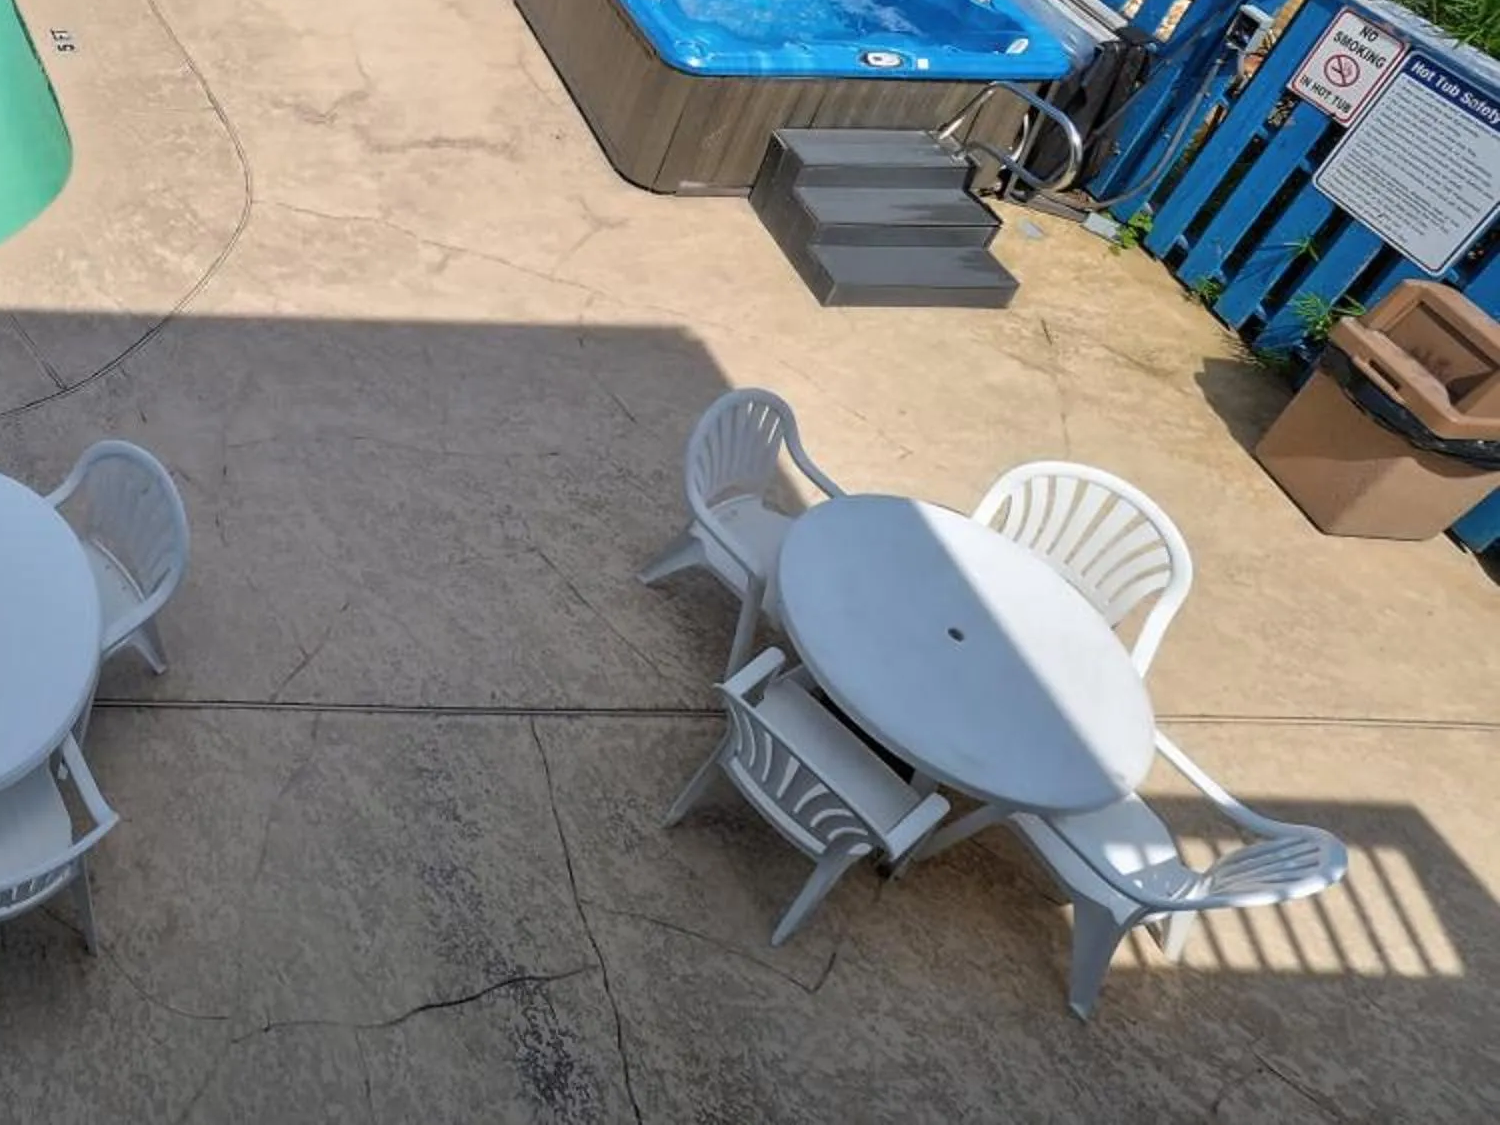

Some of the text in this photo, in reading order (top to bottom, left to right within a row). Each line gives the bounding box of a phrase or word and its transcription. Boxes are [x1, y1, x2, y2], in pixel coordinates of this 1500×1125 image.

[1333, 30, 1387, 69] SMOKING
[1359, 25, 1379, 42] NO
[1311, 82, 1332, 100] HOT
[1331, 95, 1352, 114] TUB
[1411, 60, 1500, 125] Hot Tub Safety
